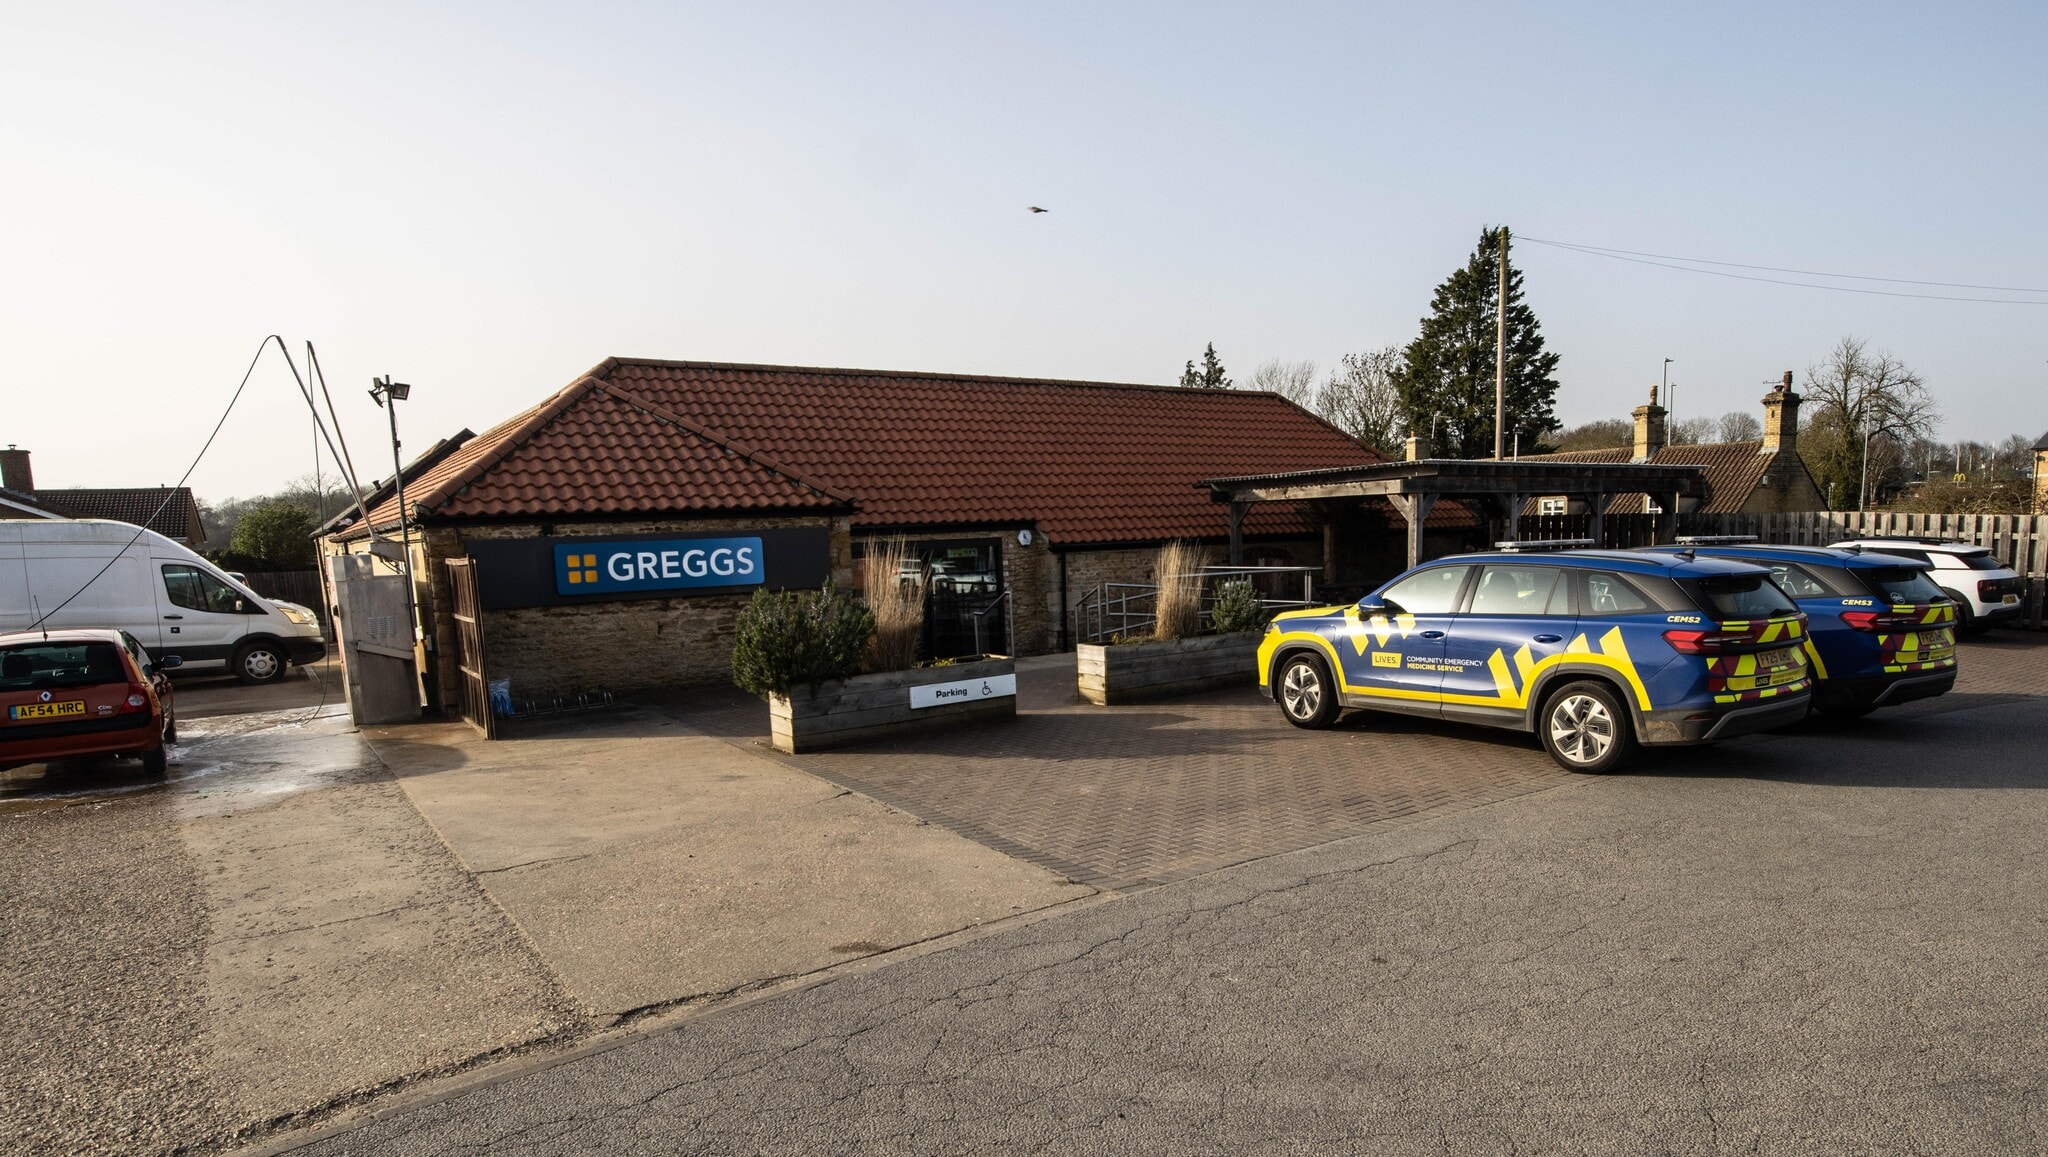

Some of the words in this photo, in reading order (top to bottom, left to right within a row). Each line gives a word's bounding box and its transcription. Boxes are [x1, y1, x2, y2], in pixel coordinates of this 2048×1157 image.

[608, 547, 754, 581] GREGGS
[1667, 616, 1701, 624] CEMS2
[1406, 656, 1443, 664] COMMUNITY
[1444, 658, 1483, 667] EMERGENCY
[1407, 663, 1436, 671] MEDICINE
[1437, 665, 1464, 673] SERVICE
[936, 688, 968, 698] Parking
[20, 704, 54, 717] AF54
[57, 702, 83, 714] HRC
